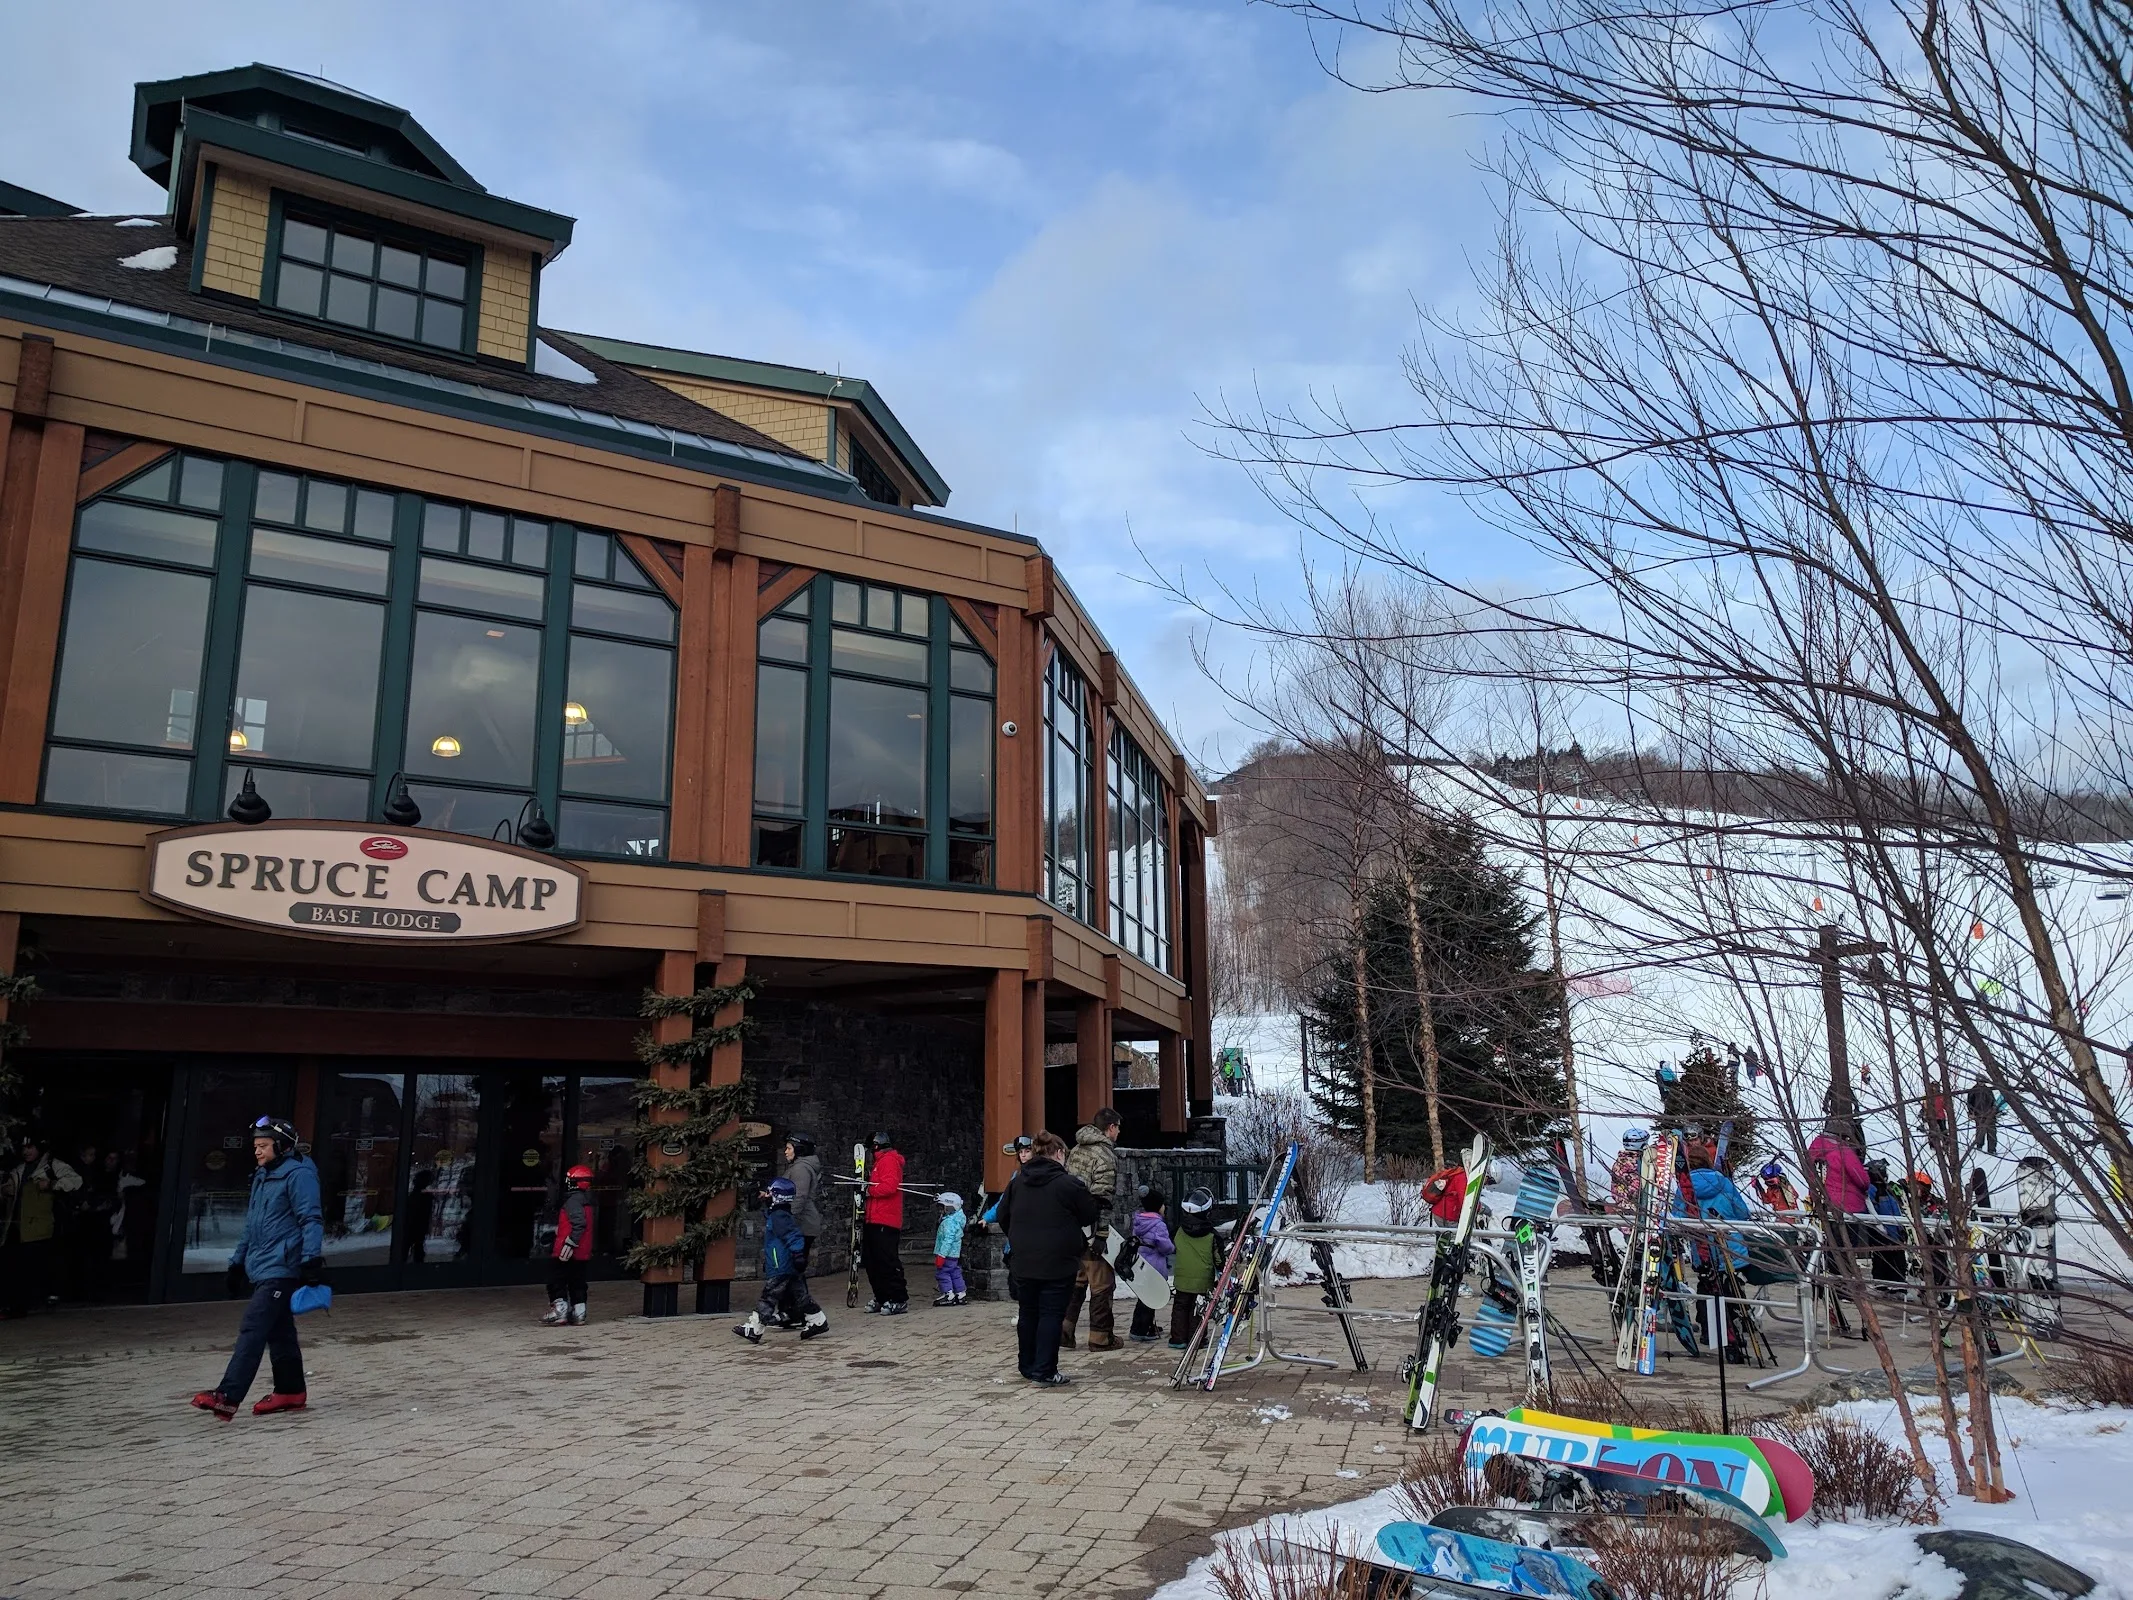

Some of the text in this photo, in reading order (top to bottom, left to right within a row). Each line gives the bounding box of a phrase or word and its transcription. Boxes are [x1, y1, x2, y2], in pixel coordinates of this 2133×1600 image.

[185, 850, 558, 911] SPRUCE CAMP
[311, 907, 441, 930] BASE LODGE
[1473, 1552, 1513, 1568] BURTO
